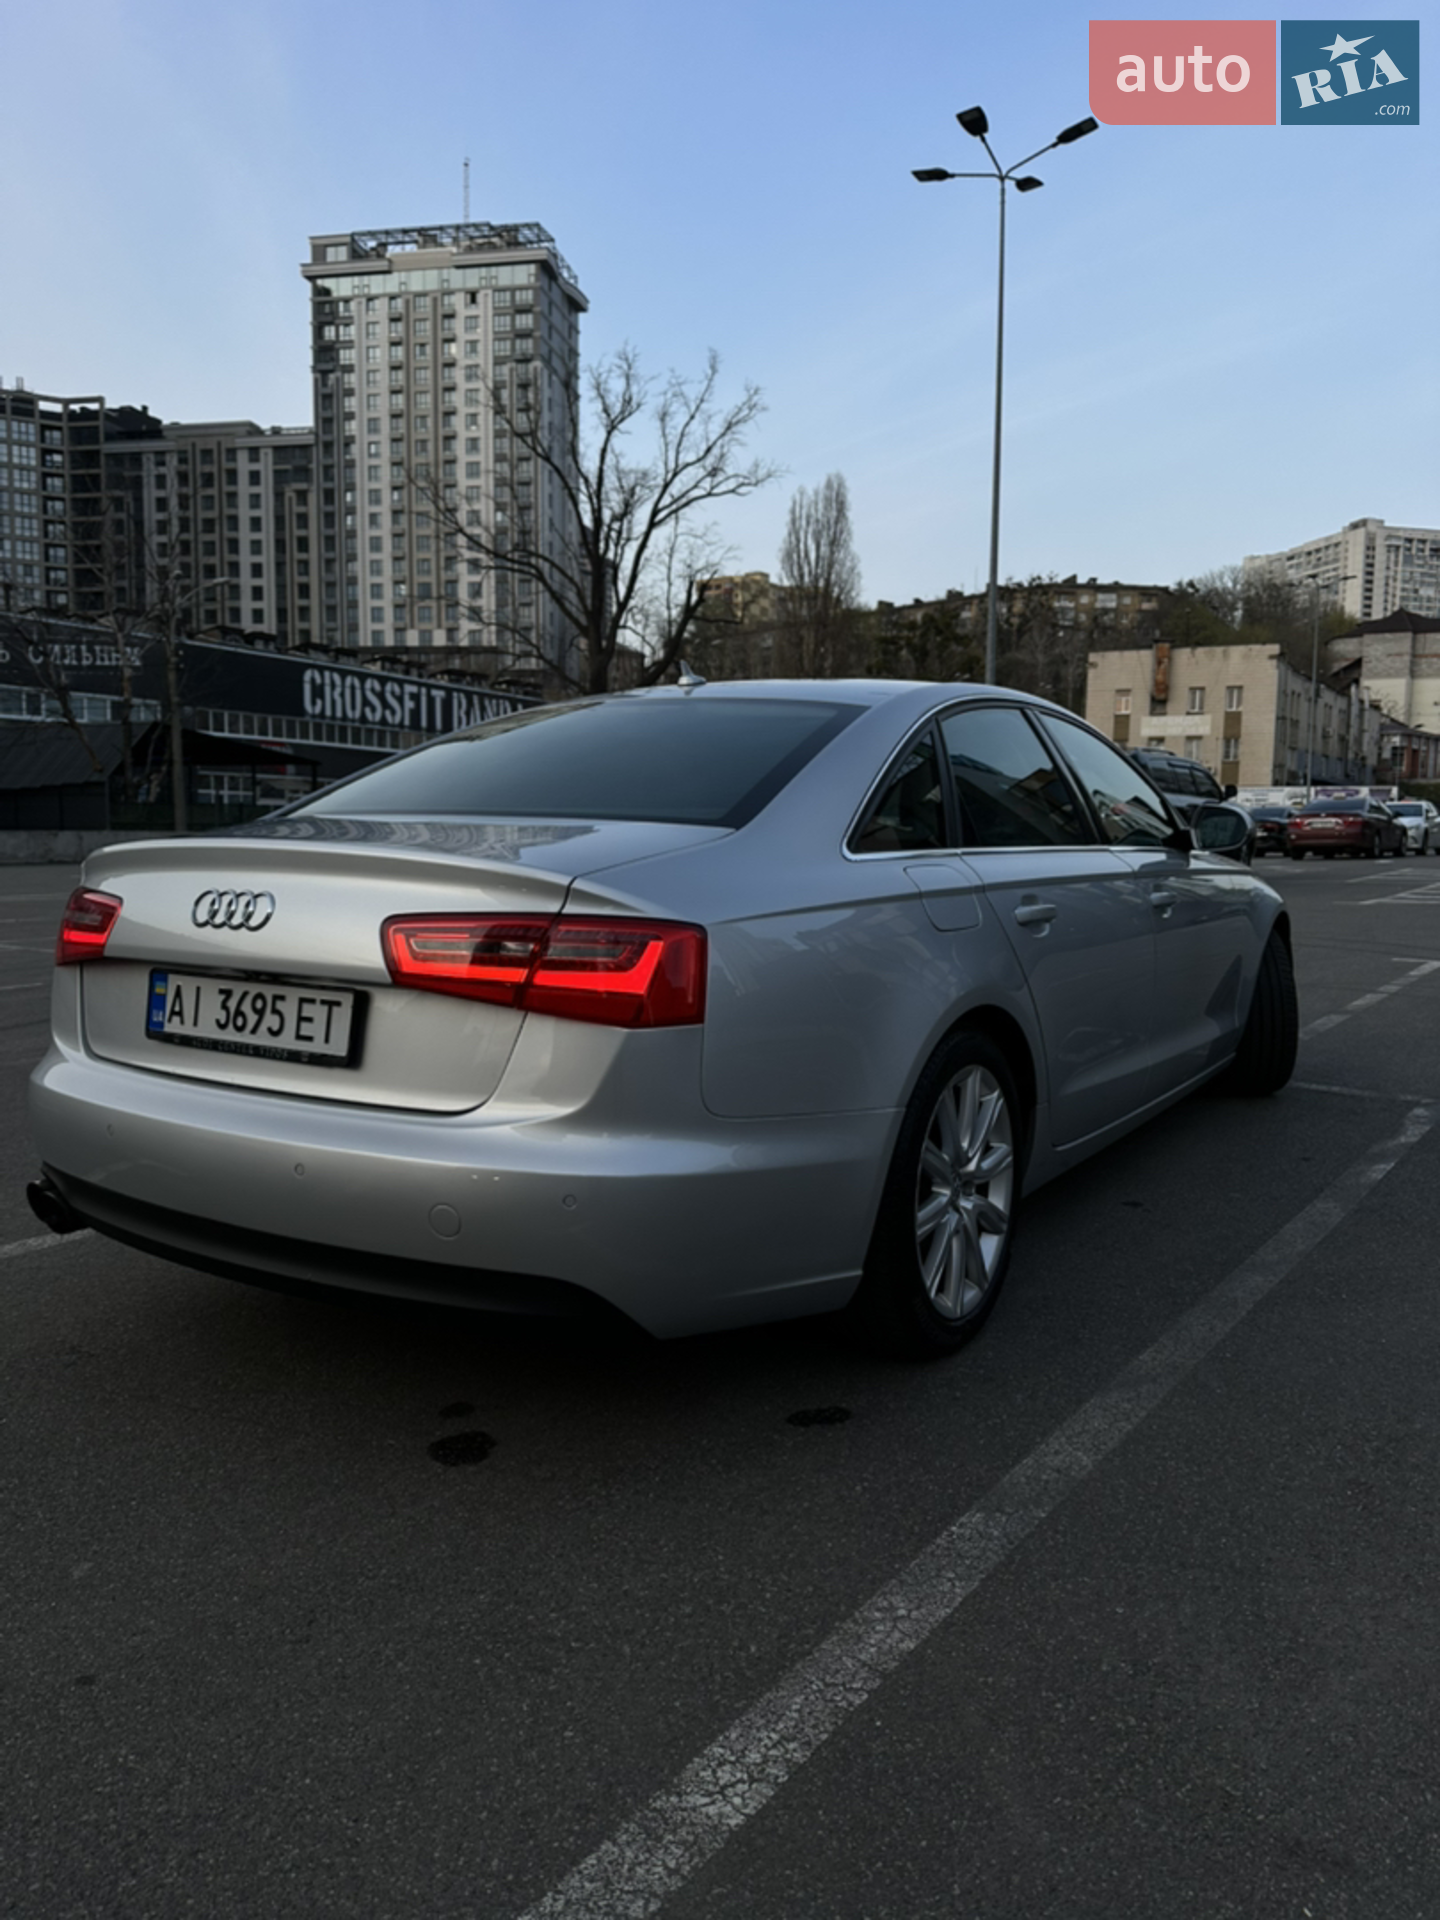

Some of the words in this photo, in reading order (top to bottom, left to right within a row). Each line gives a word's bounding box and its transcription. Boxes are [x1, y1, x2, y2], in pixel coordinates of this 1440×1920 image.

[303, 668, 446, 731] CROSSFIT
[167, 984, 201, 1027] AI
[215, 988, 287, 1037] 3695
[295, 996, 342, 1044] ET
